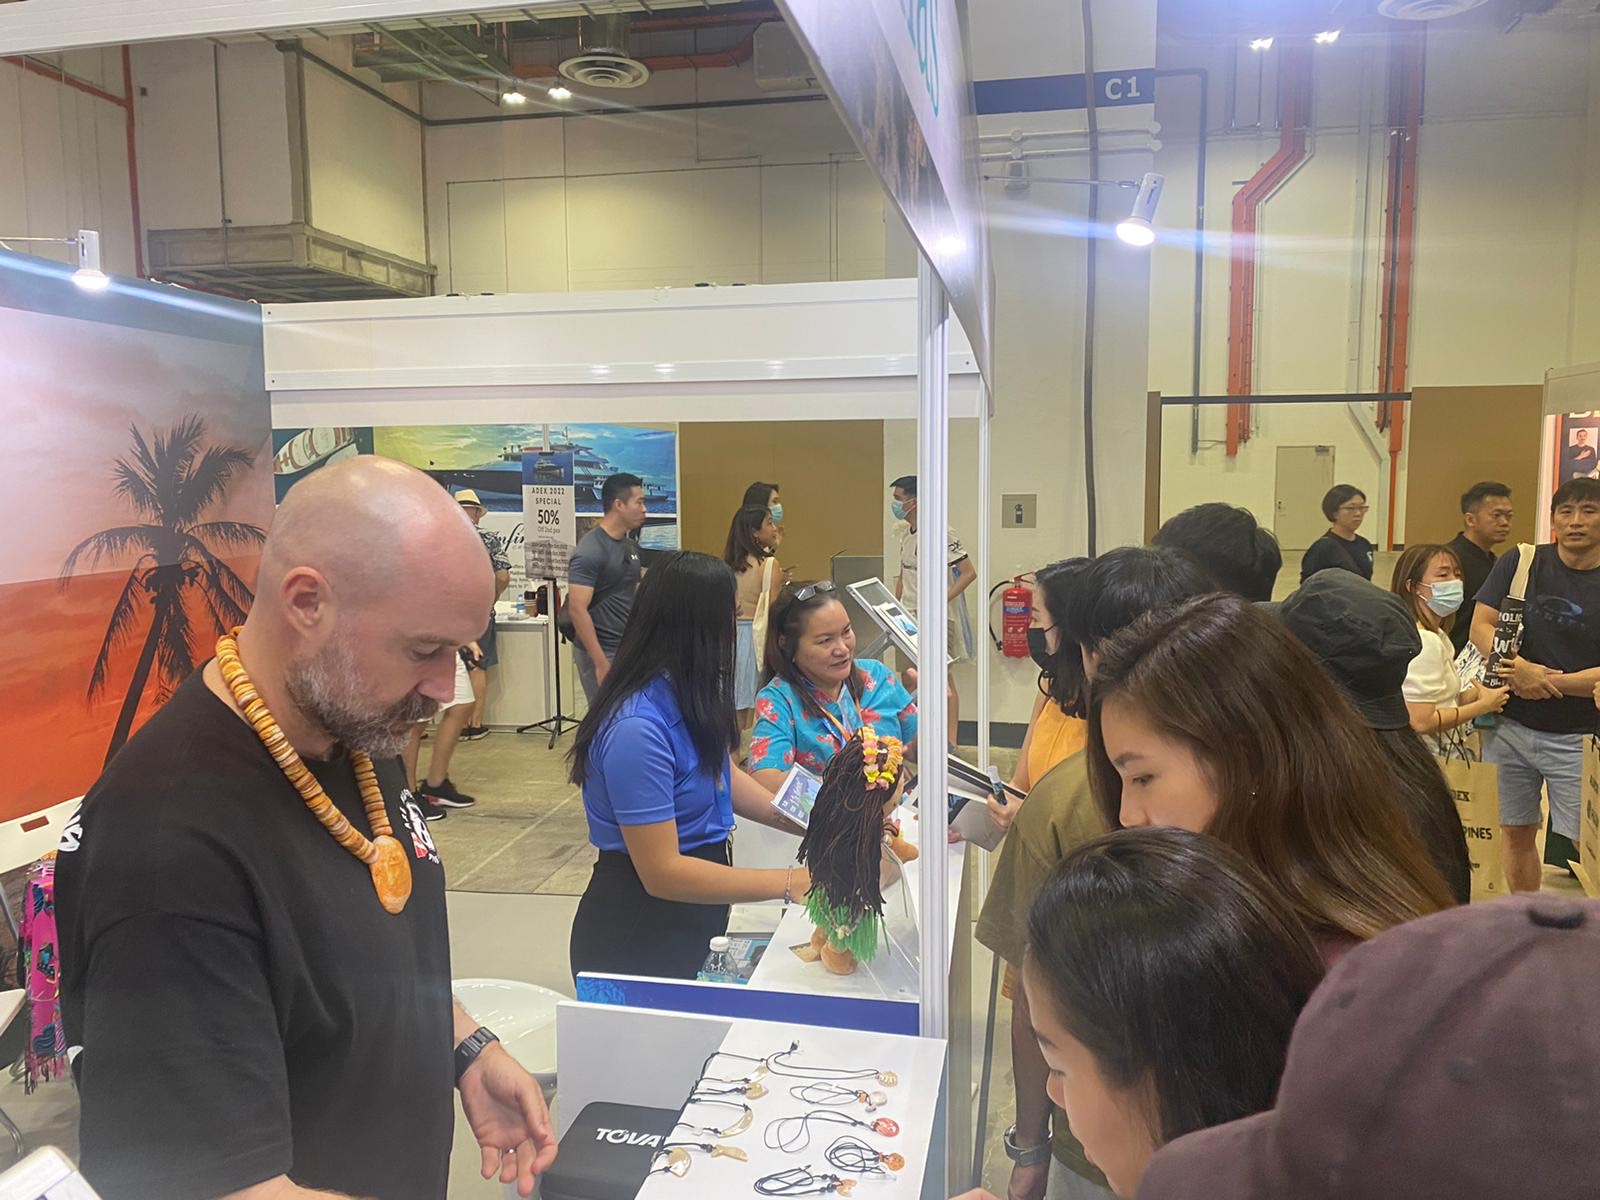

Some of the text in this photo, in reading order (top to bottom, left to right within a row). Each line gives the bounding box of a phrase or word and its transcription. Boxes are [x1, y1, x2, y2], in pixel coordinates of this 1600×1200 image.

[1105, 76, 1140, 100] C1
[532, 487, 565, 495] ADEX 2022
[535, 497, 561, 506] SPECIAL
[537, 509, 560, 525] 50%
[595, 1127, 664, 1148] TOVA
